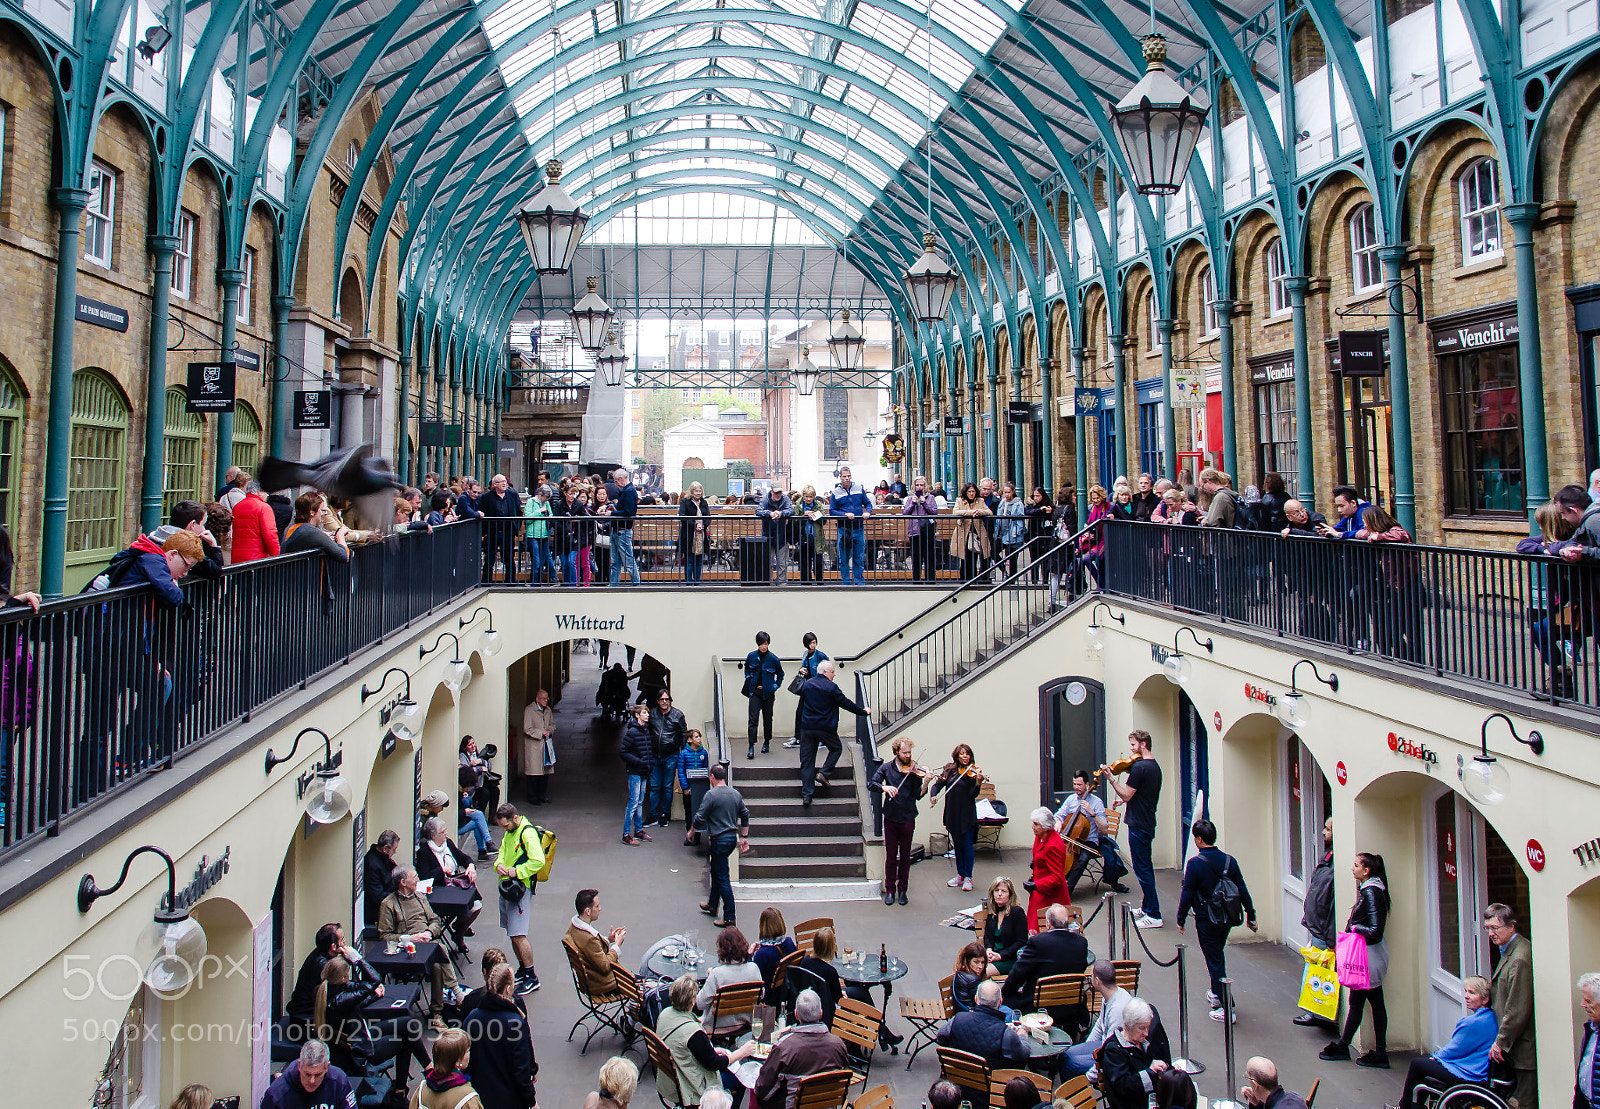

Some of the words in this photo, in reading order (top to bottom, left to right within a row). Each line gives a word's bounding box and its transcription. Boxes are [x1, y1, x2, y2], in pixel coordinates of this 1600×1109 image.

[88, 306, 100, 317] PAIN
[1458, 321, 1506, 348] Venchi
[1266, 362, 1294, 381] Venchi
[555, 614, 625, 631] Whittard
[1397, 736, 1438, 764] 2theloo
[1336, 766, 1347, 781] WC
[1527, 846, 1543, 864] WC
[1572, 837, 1600, 867] TH
[1444, 862, 1457, 877] WC
